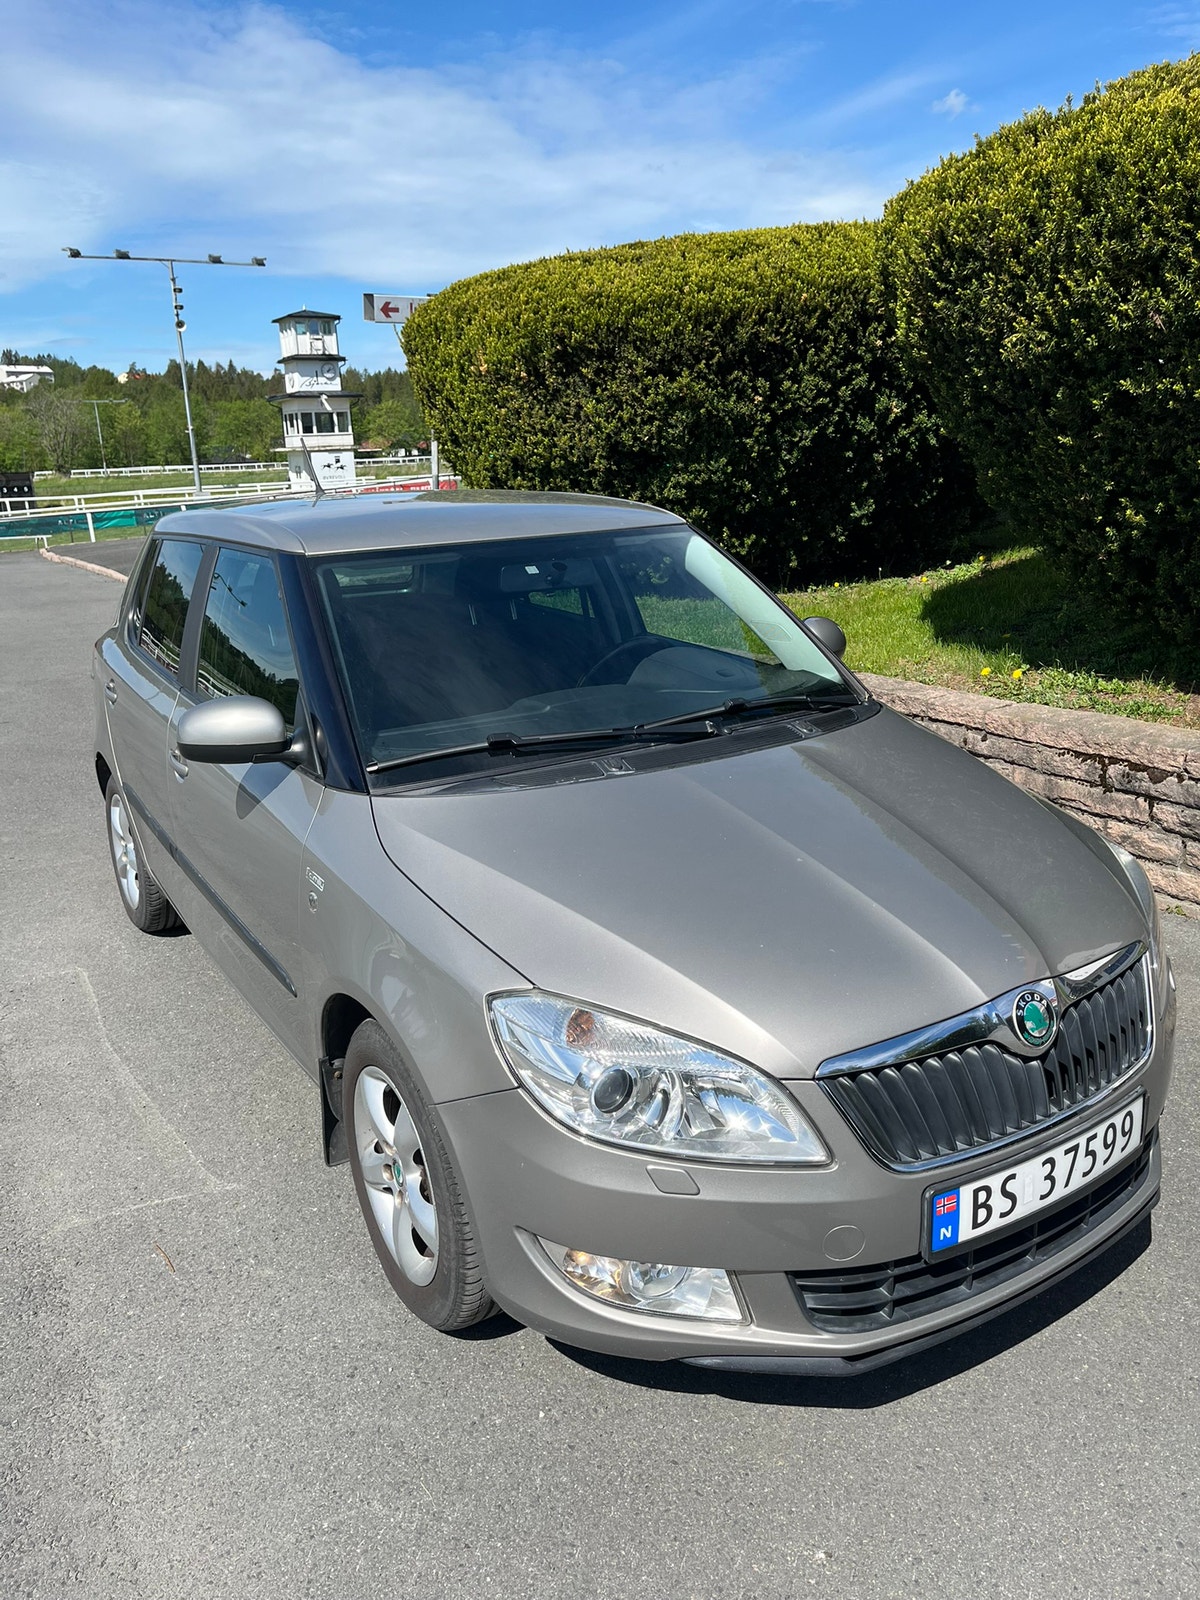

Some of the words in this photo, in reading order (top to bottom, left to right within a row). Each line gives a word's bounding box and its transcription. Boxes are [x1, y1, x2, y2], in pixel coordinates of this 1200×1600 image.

[971, 1173, 1018, 1231] BS
[1039, 1110, 1134, 1201] 37599
[939, 1225, 952, 1240] N
